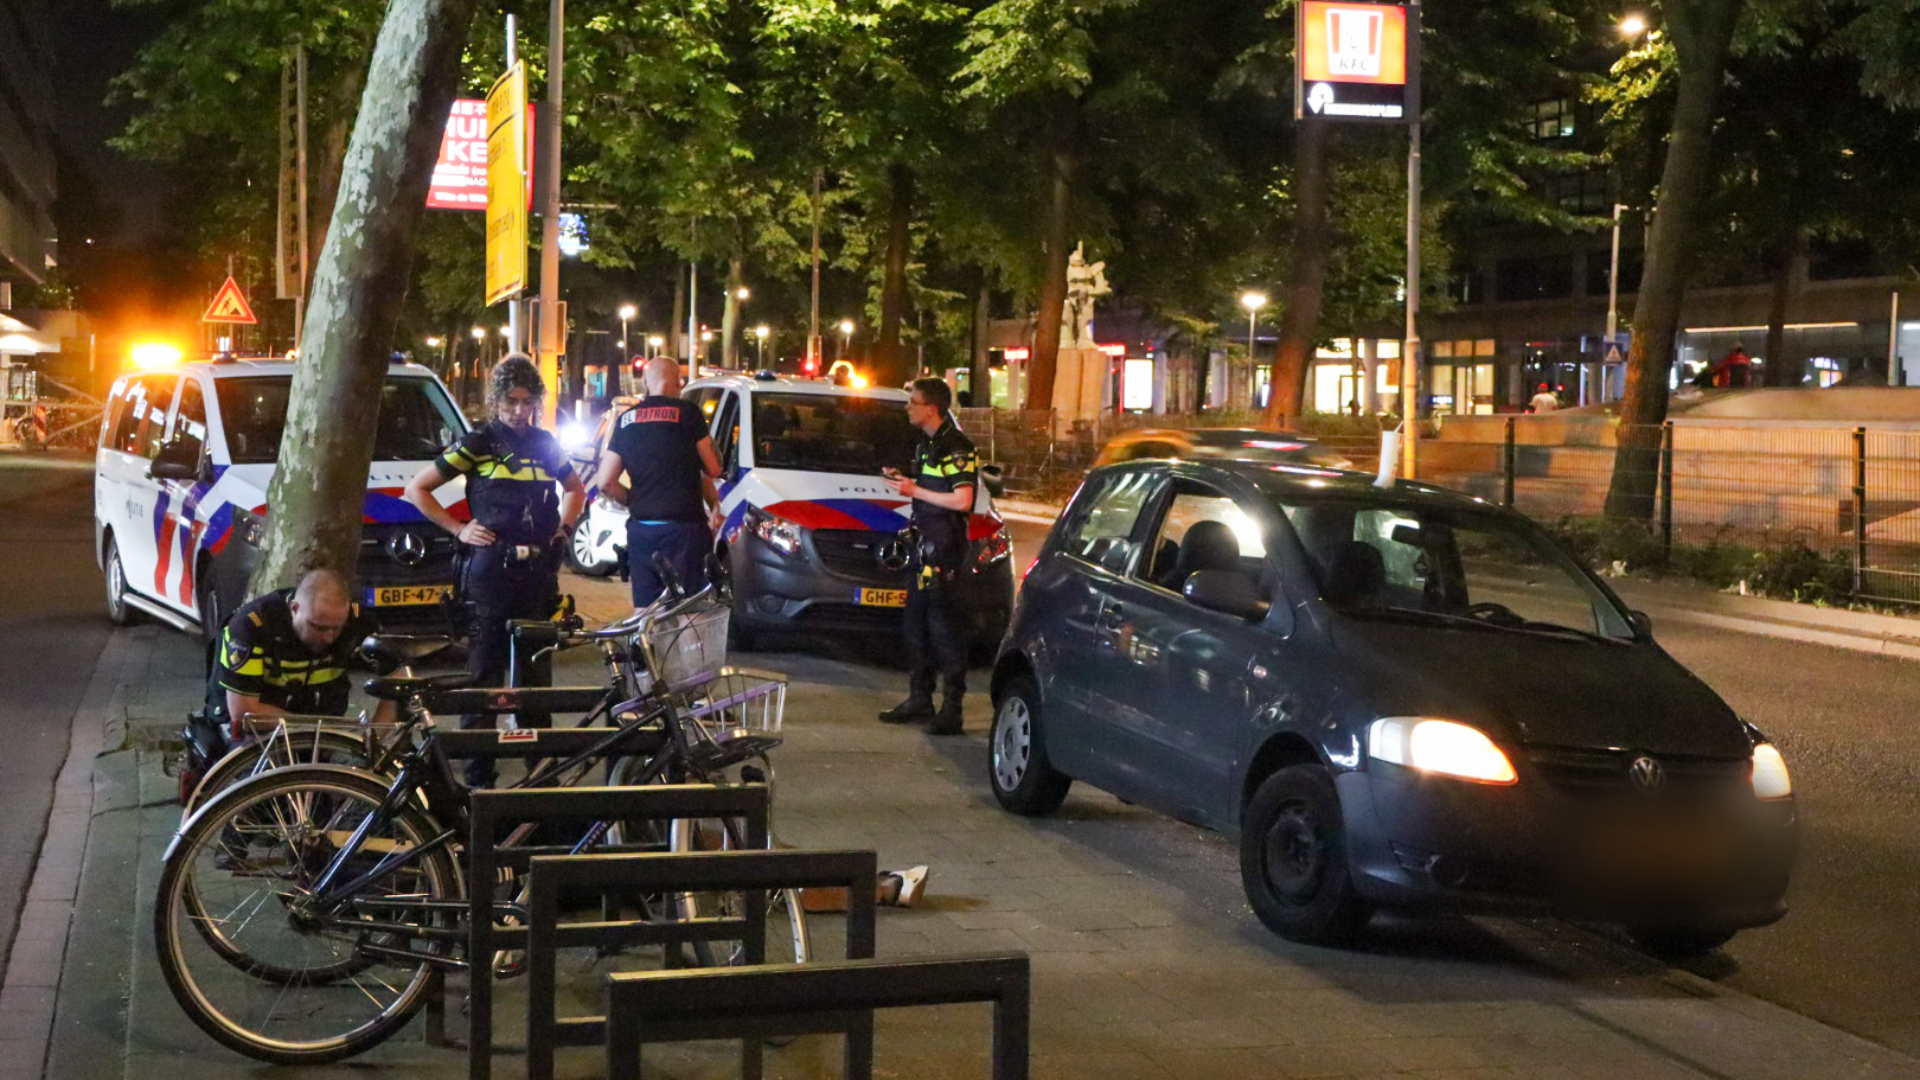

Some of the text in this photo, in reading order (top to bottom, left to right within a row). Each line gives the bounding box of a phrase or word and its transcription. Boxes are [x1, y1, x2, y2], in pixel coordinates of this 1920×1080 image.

[1339, 58, 1368, 71] KFC
[636, 408, 679, 422] PATRON
[839, 486, 893, 494] POLI
[865, 590, 908, 605] GHF-5
